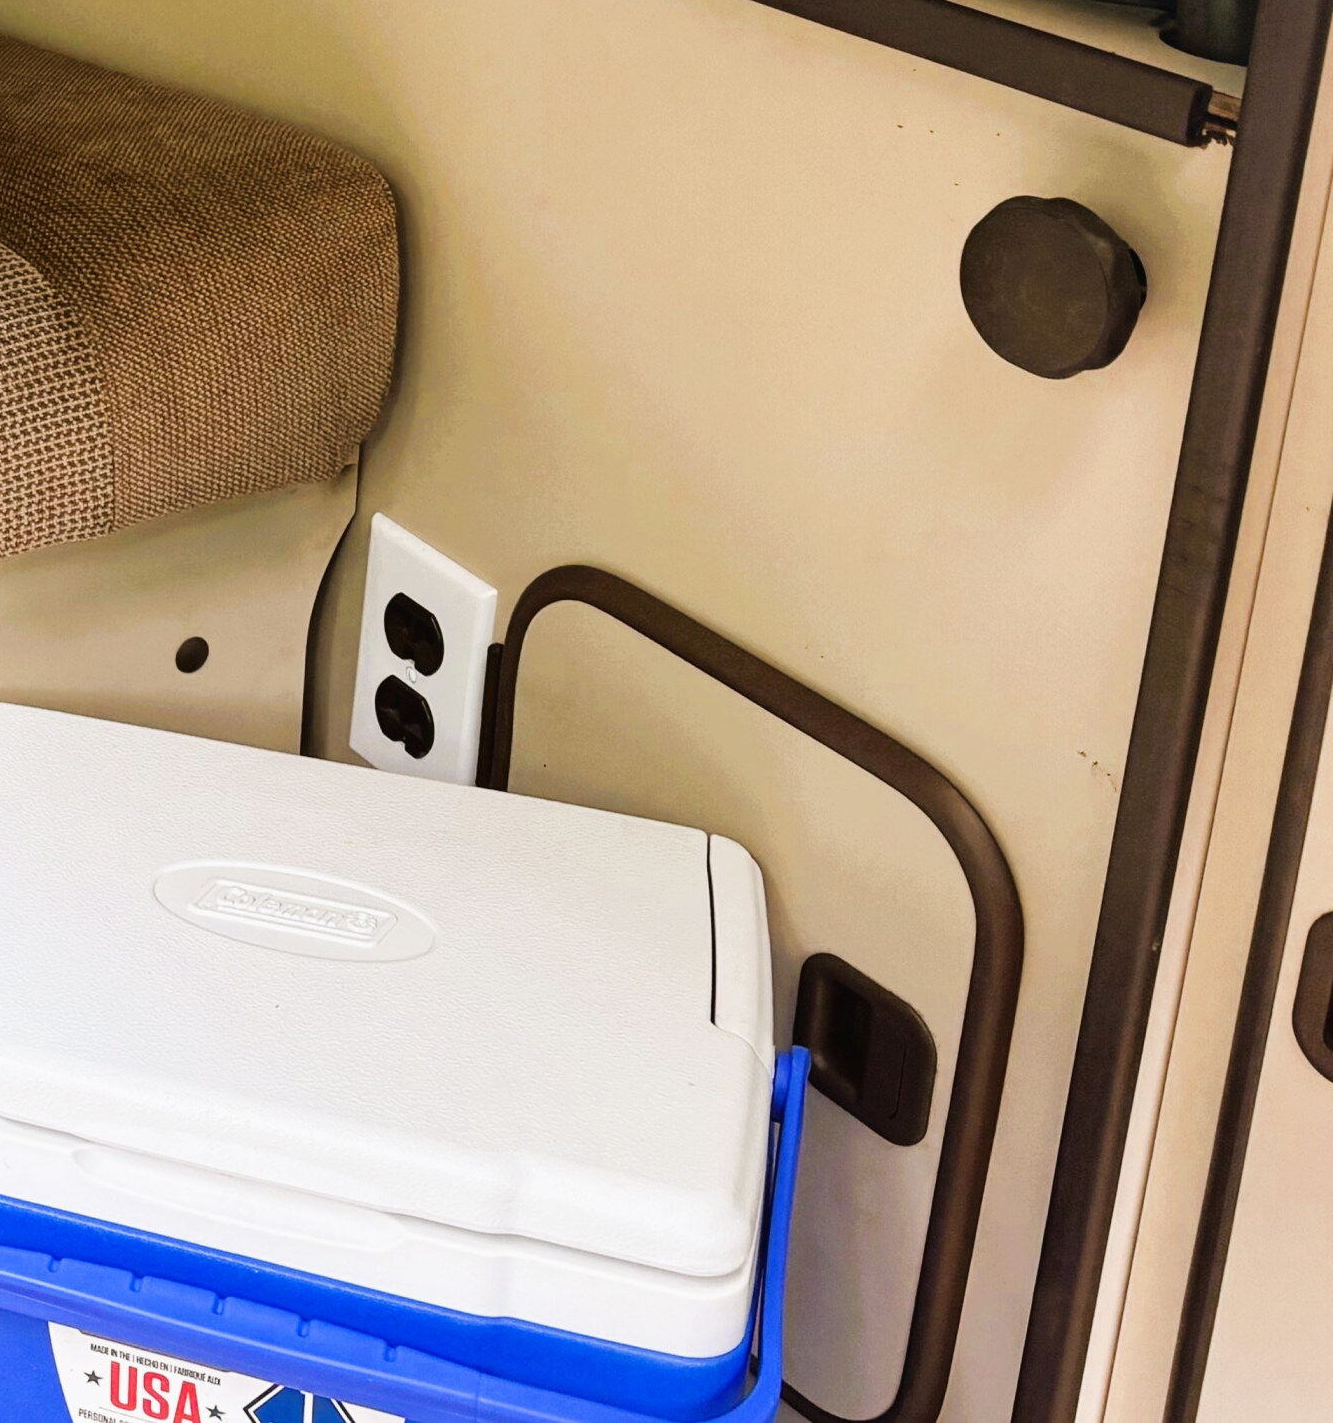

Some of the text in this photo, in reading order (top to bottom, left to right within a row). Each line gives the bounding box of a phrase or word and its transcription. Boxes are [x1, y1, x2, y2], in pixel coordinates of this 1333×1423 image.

[216, 886, 344, 927] Coleman
[90, 1343, 109, 1355] MADE
[111, 1349, 118, 1358] IN
[119, 1351, 131, 1361] THE
[136, 1356, 159, 1368] HECHO
[160, 1363, 169, 1372] EN
[110, 1361, 202, 1423] USA
